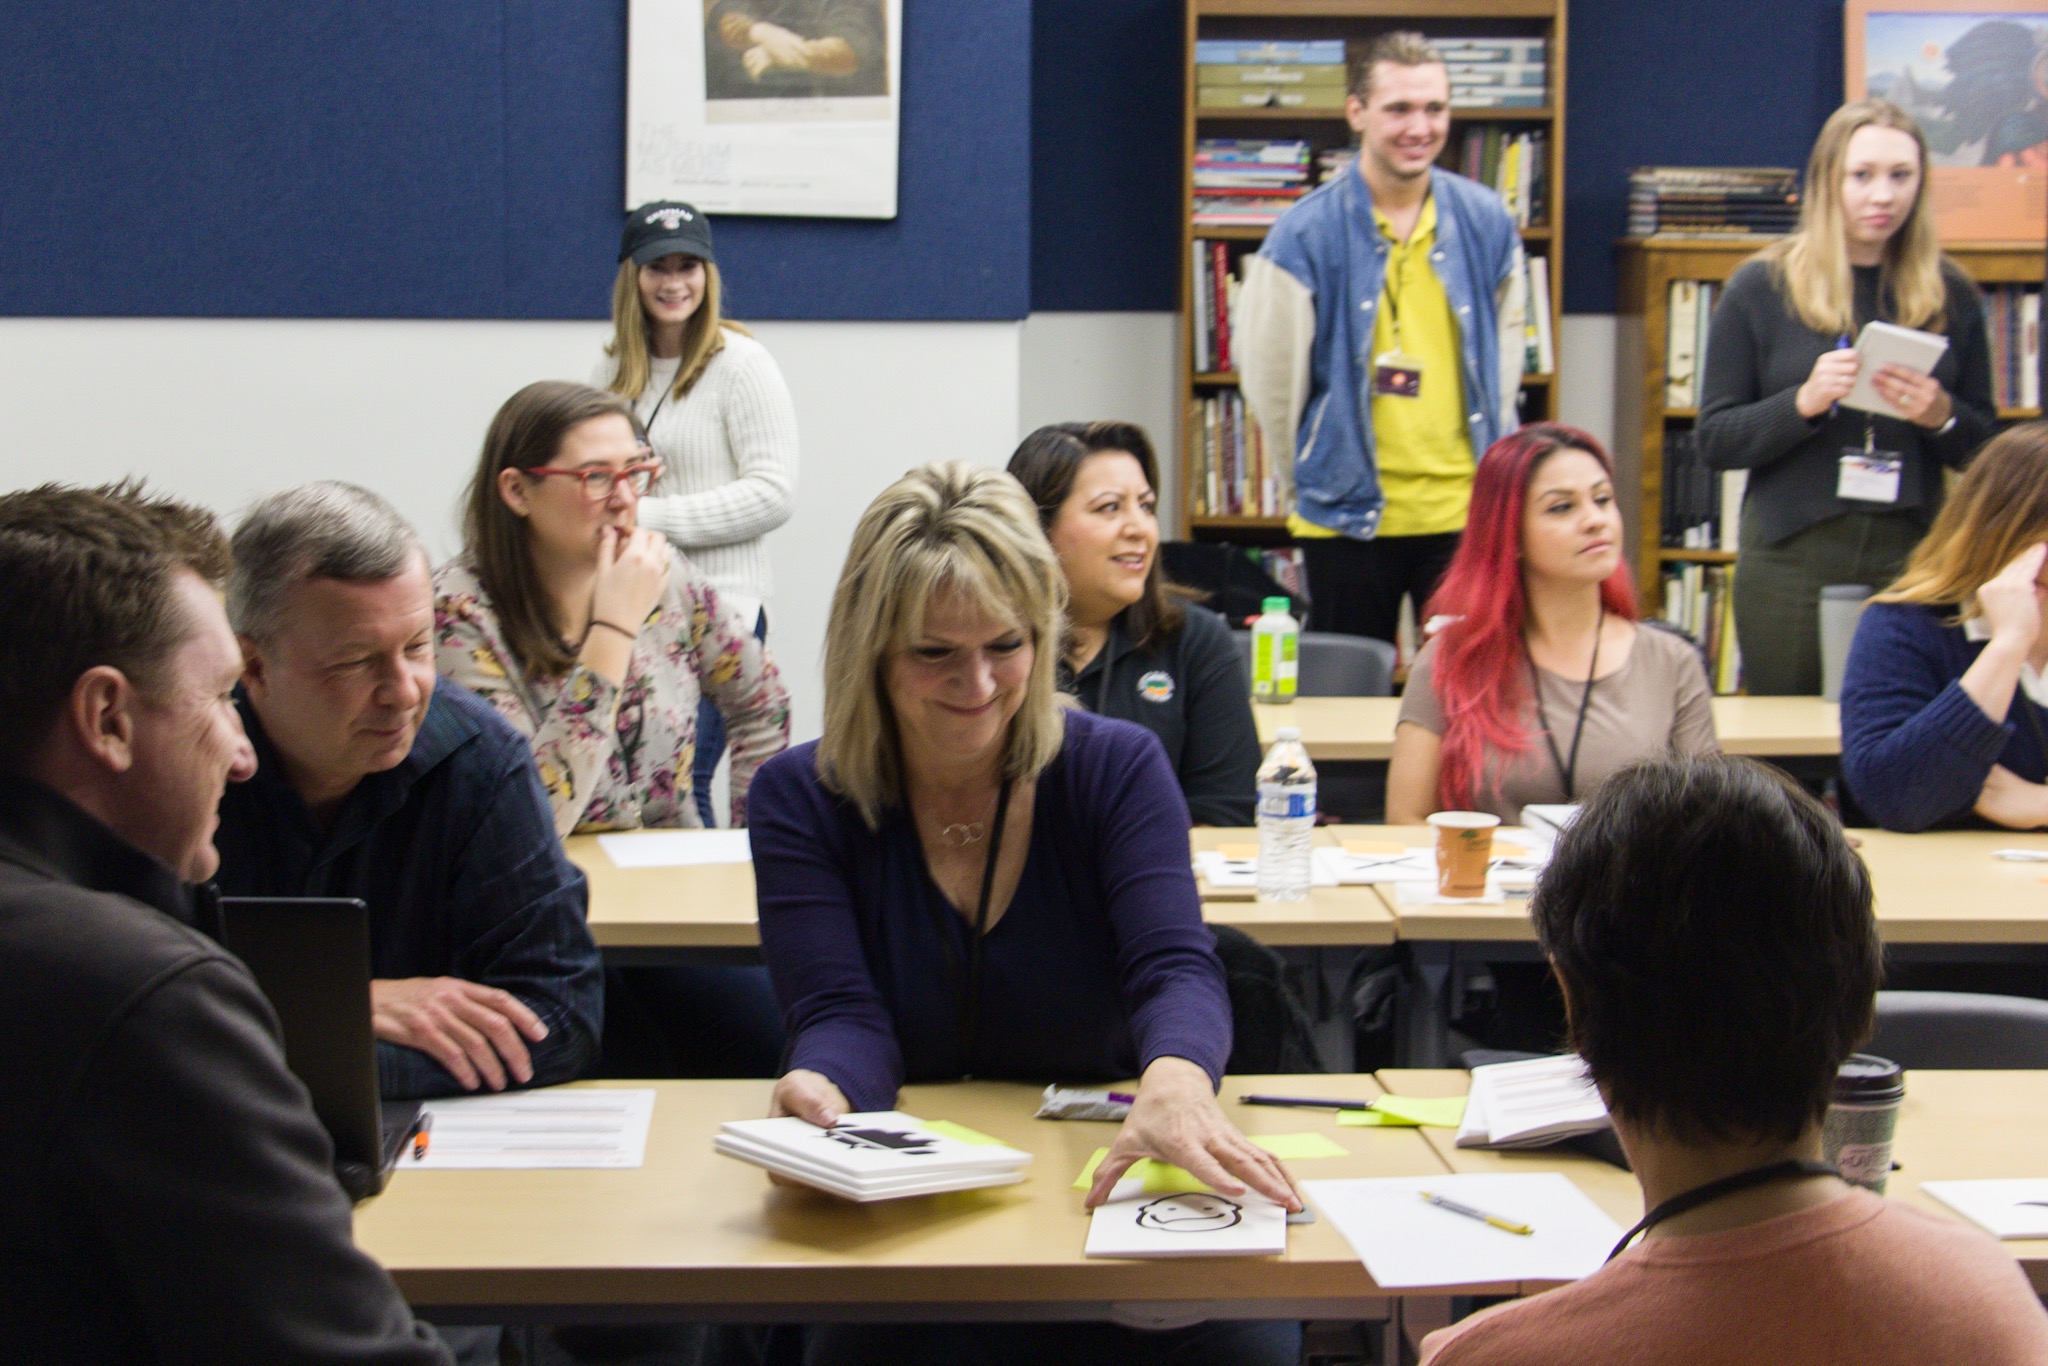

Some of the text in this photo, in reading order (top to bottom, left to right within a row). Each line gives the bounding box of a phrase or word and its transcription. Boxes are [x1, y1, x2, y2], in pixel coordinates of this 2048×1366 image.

[638, 121, 677, 138] THE
[637, 140, 732, 158] MUSEUM
[637, 157, 666, 175] AS
